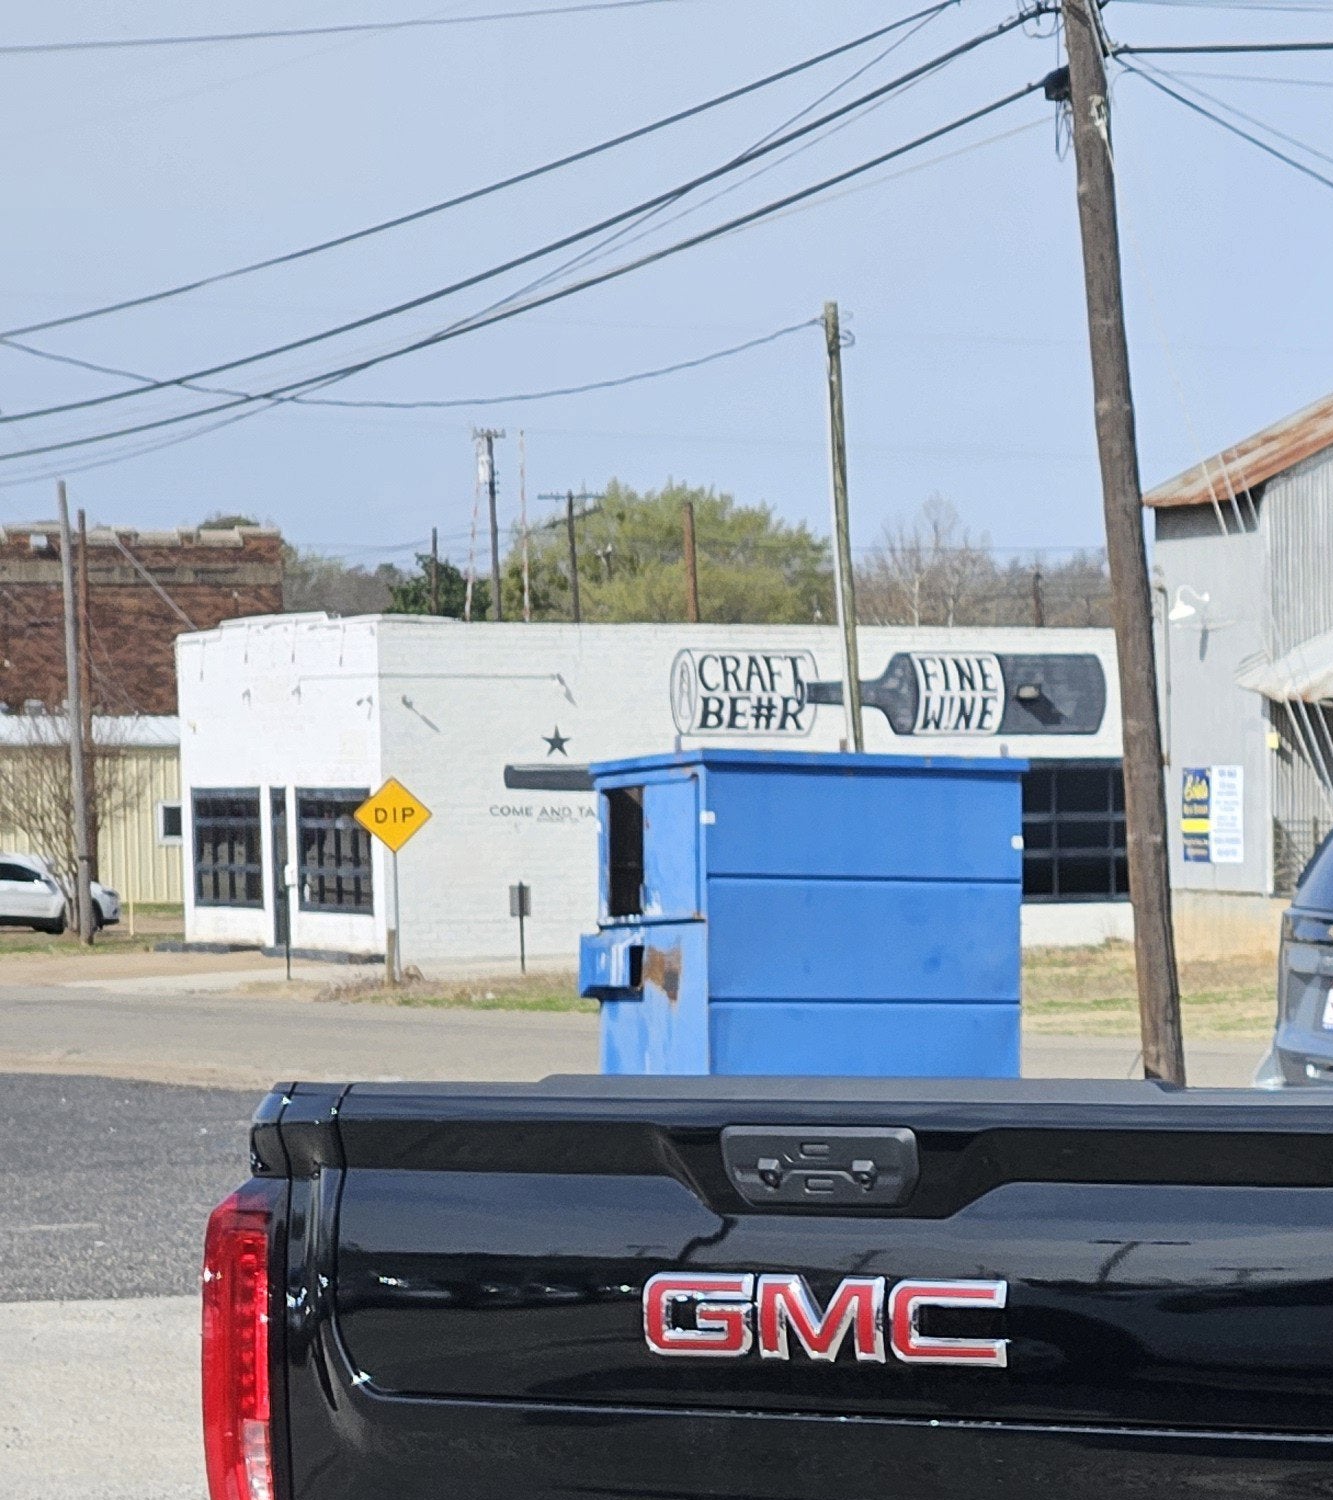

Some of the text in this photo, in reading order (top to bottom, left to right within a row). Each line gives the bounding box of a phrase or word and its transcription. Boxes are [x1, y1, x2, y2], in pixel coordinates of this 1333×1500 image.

[698, 654, 806, 693] CRAFT
[918, 656, 998, 693] FINE
[374, 807, 415, 823] DIP
[489, 805, 533, 817] COME
[539, 806, 573, 818] AND
[641, 1271, 1009, 1369] GMC
